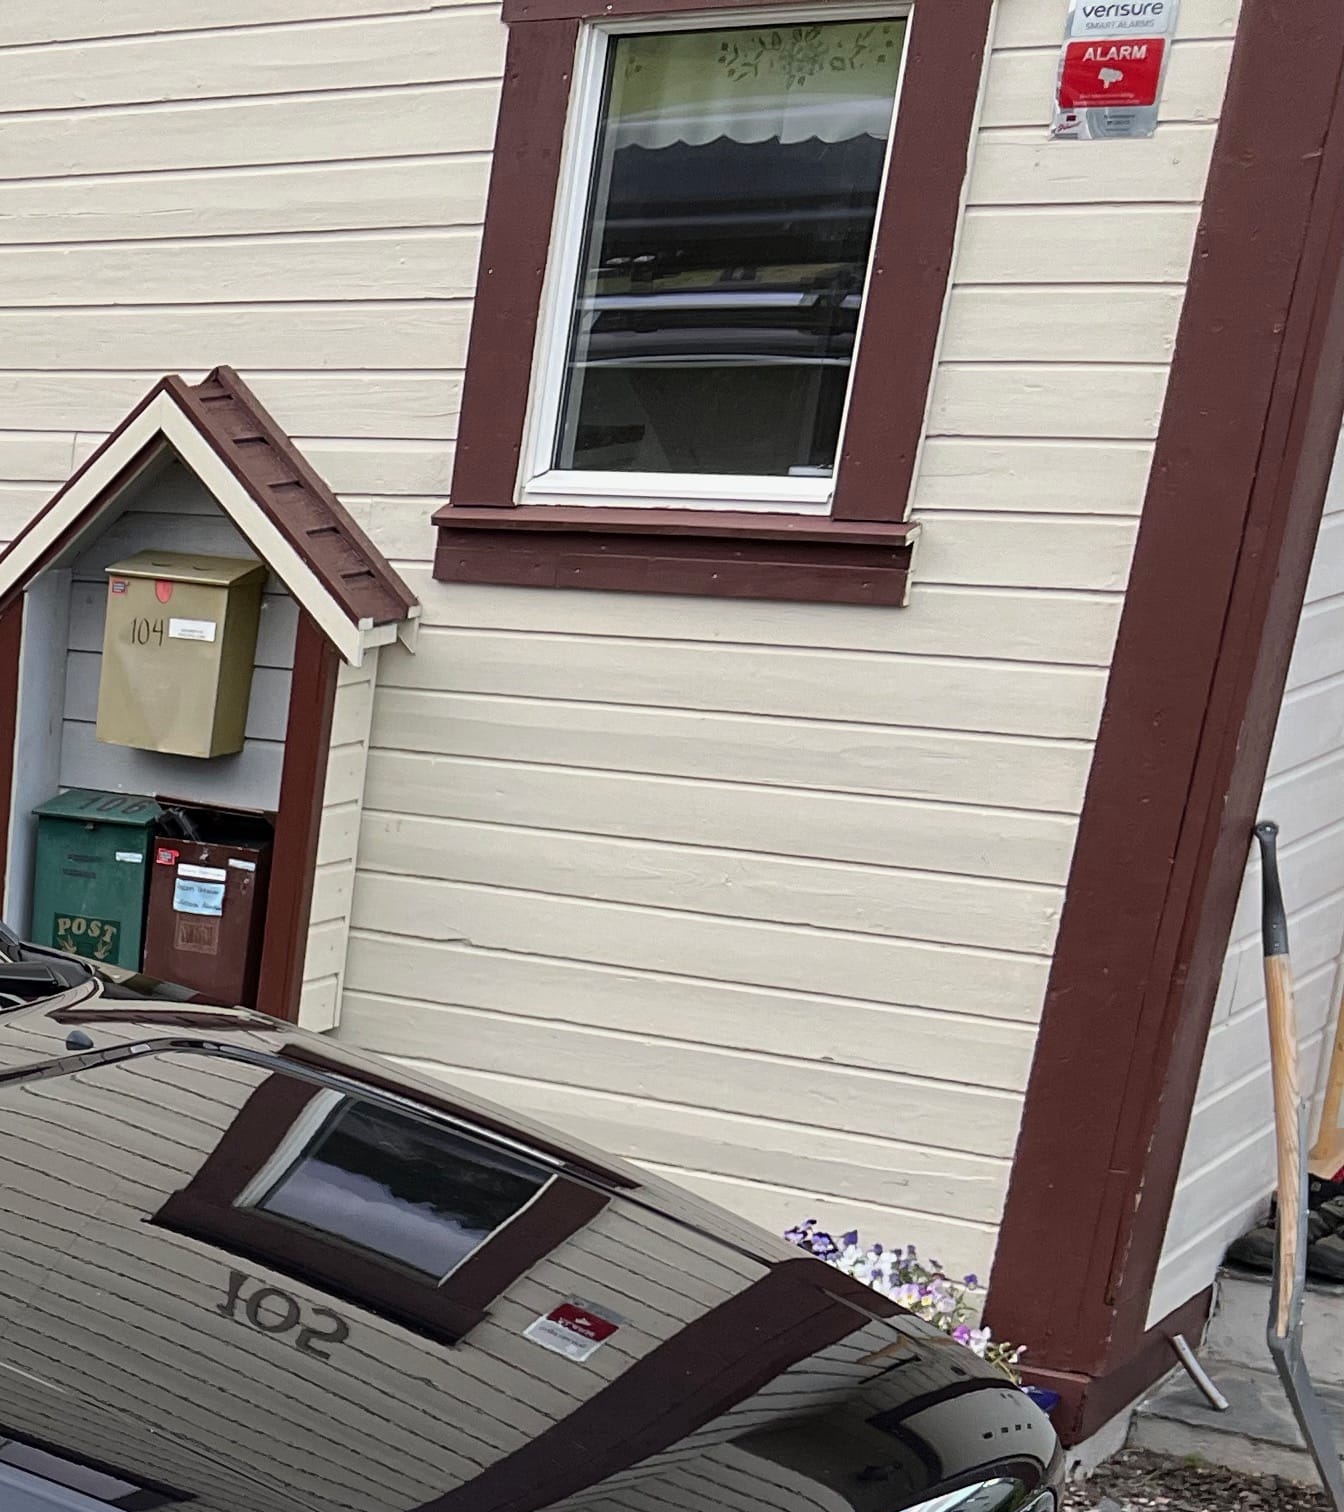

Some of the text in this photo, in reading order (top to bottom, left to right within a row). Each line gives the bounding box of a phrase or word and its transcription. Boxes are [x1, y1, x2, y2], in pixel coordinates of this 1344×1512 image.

[1083, 2, 1164, 17] verisure
[1082, 45, 1148, 62] ALARM
[131, 617, 164, 647] 104
[57, 918, 117, 942] POST
